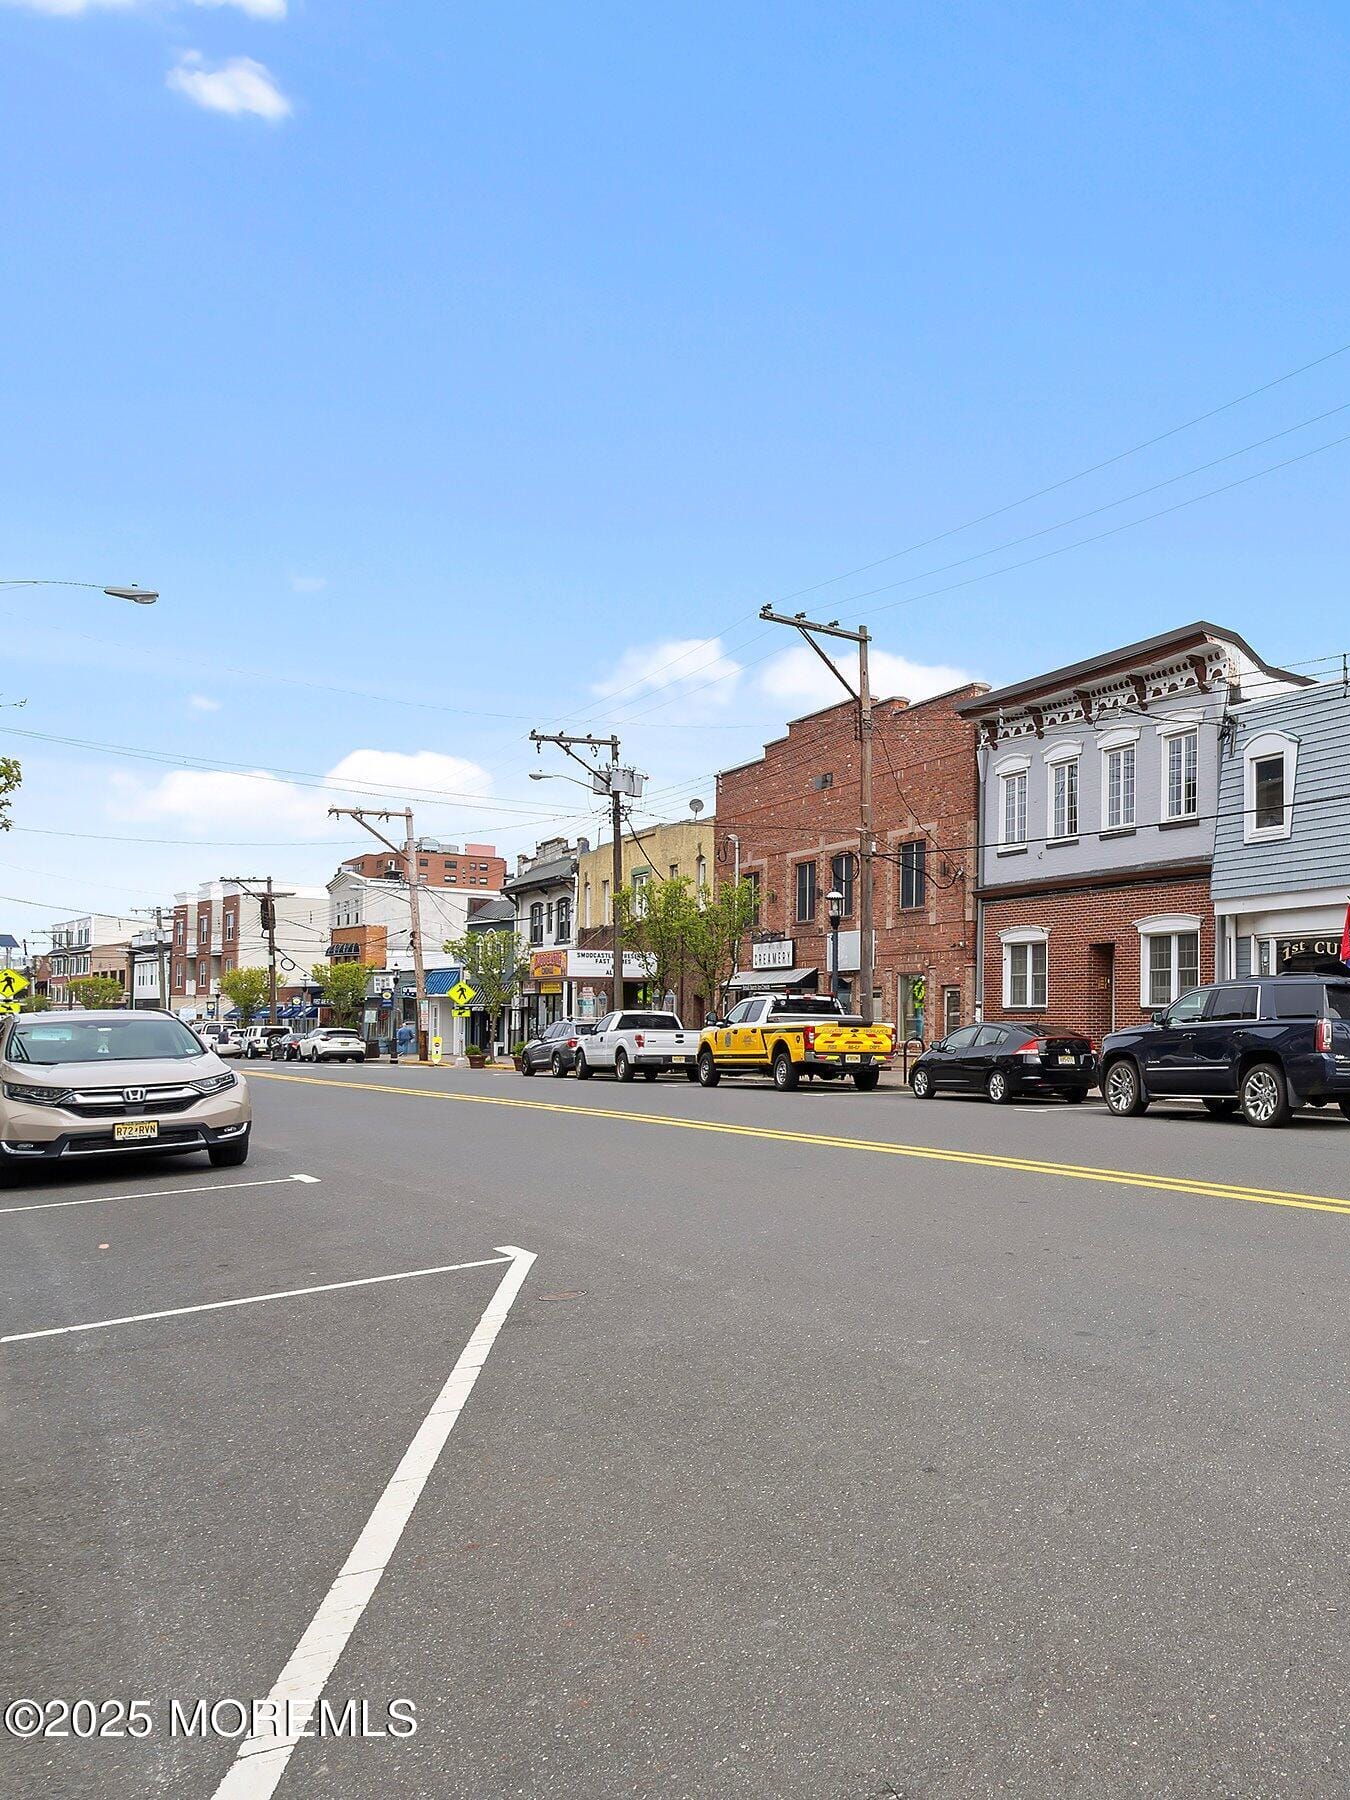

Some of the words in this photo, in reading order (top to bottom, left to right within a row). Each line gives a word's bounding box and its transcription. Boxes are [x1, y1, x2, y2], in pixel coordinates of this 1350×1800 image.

[754, 951, 791, 966] CREAMERY
[1282, 941, 1306, 961] 1st
[1314, 941, 1338, 955] CU
